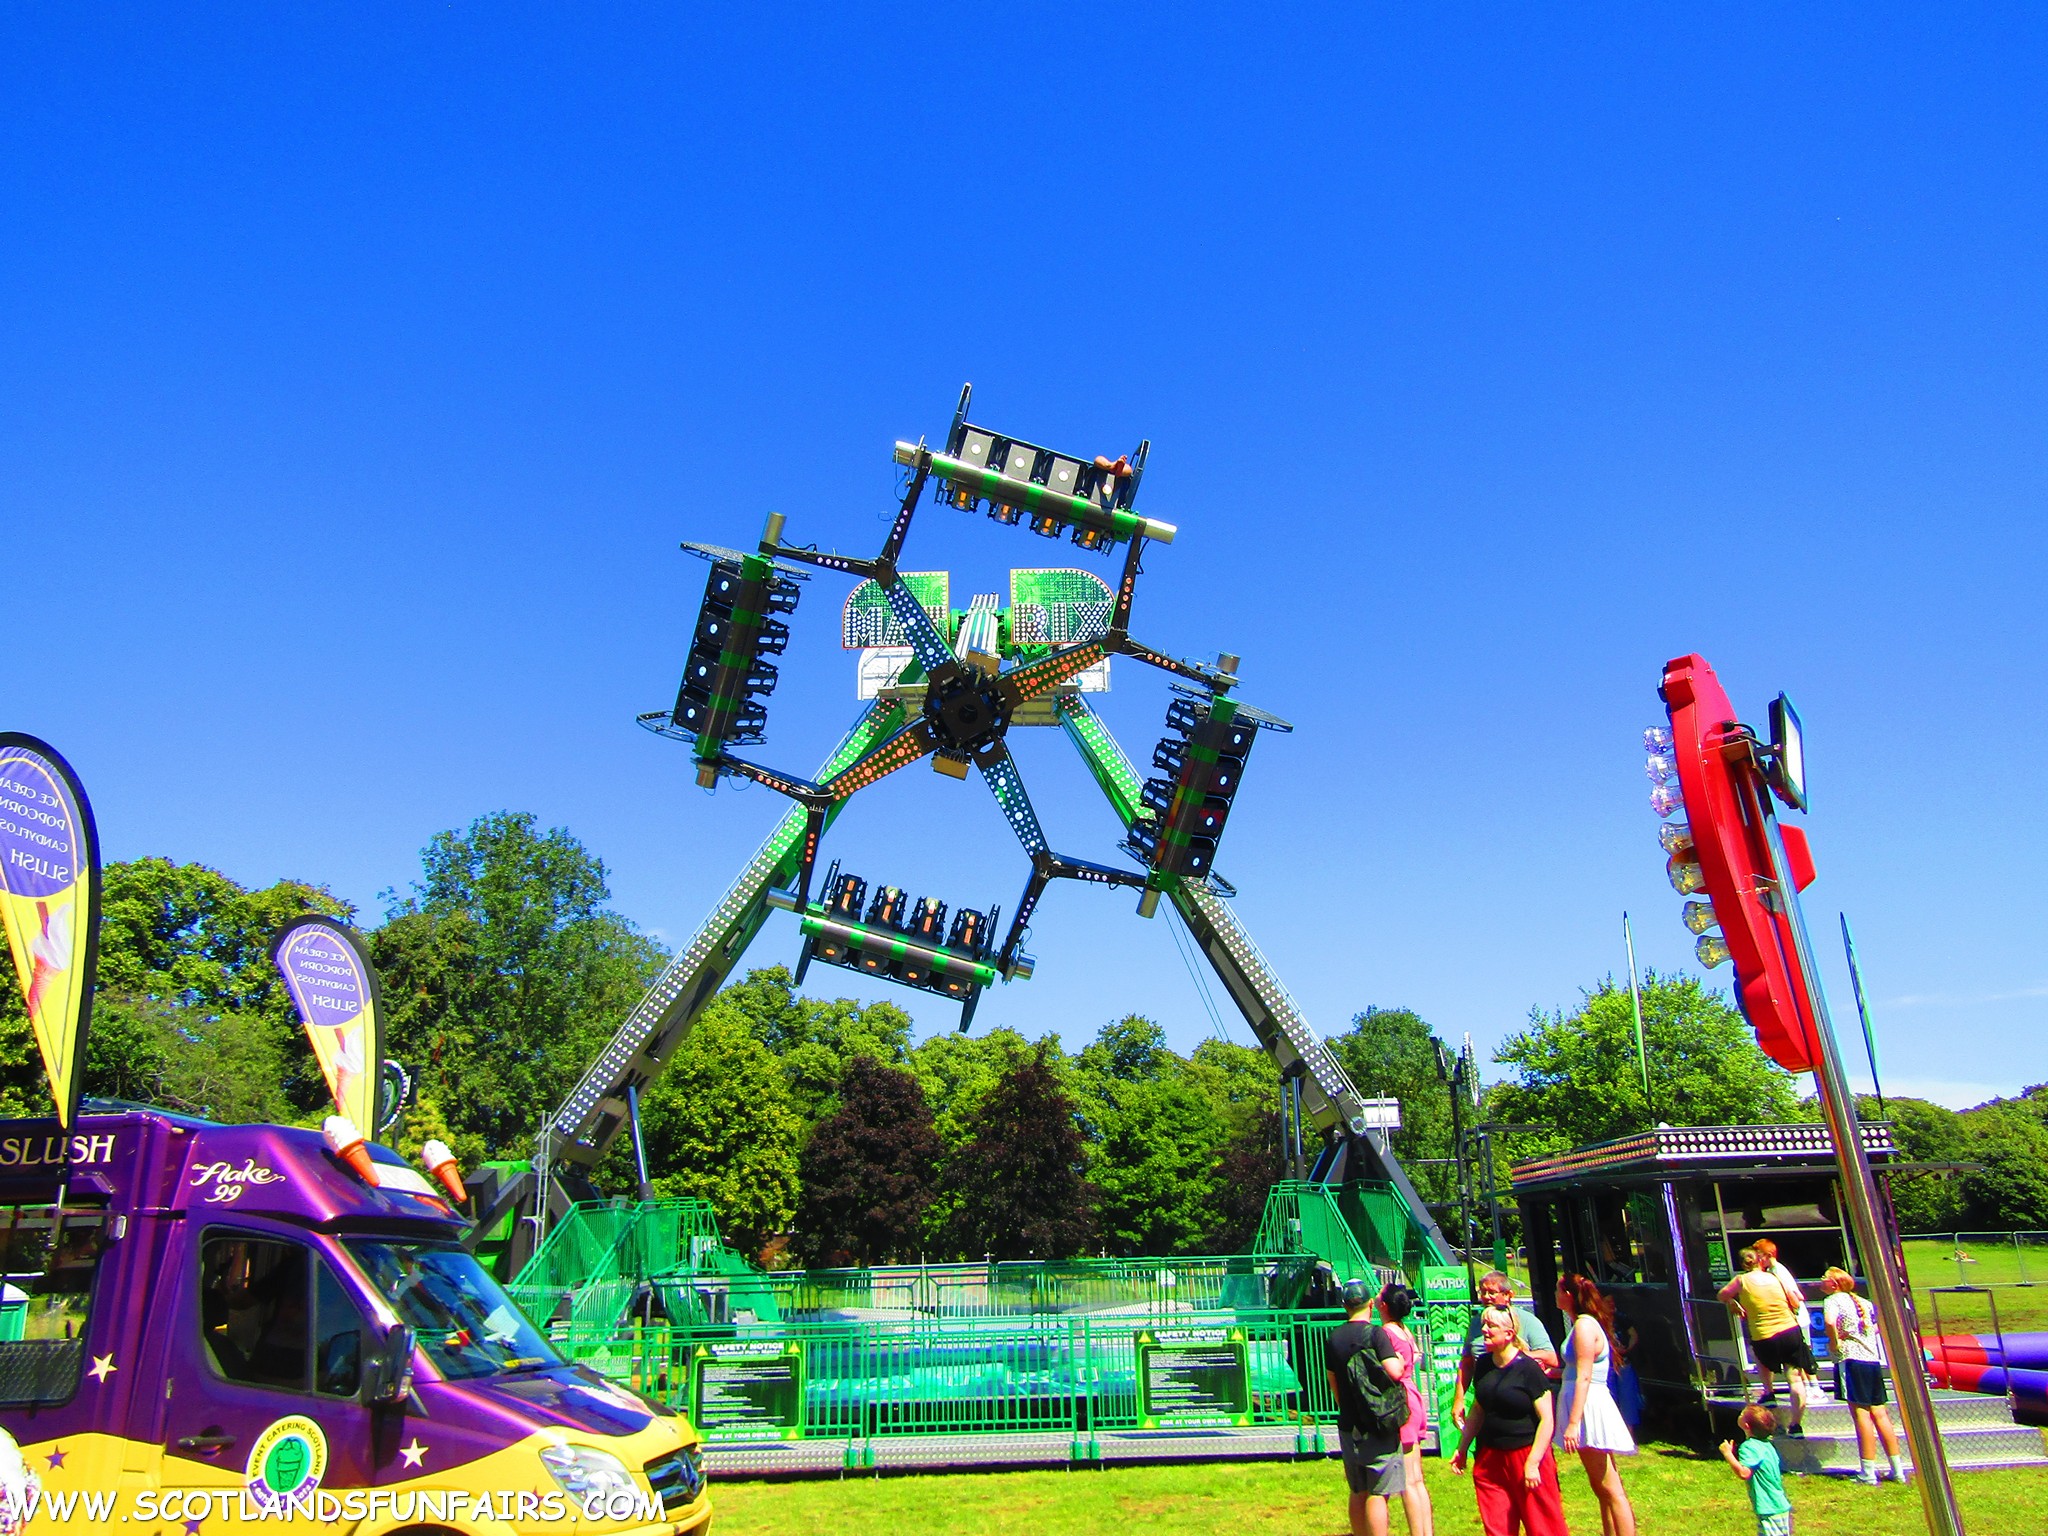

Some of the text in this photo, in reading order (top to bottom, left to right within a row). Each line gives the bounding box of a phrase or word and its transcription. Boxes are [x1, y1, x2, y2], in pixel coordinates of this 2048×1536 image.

[204, 1184, 243, 1203] 99
[1426, 1277, 1467, 1290] MATRIX
[1443, 1333, 1461, 1342] YOU
[1434, 1346, 1458, 1356] MUST
[1434, 1359, 1453, 1369] THIS
[252, 1422, 322, 1478] EVENT CATERING SCOTLAND
